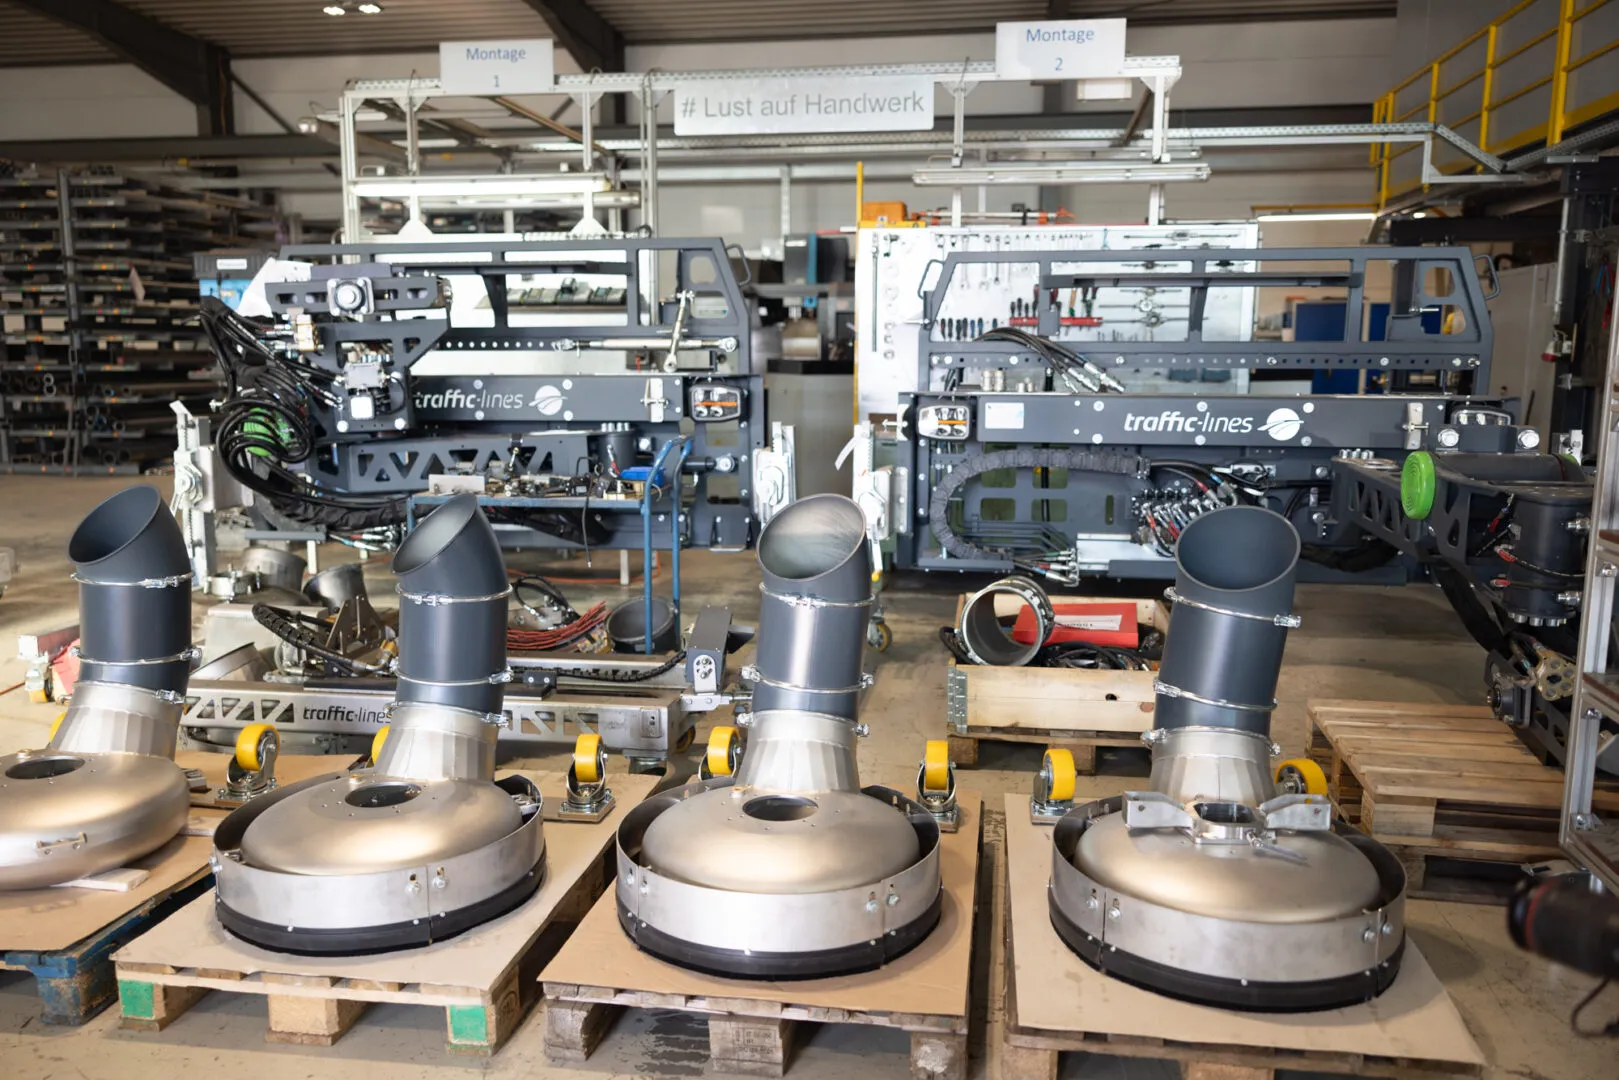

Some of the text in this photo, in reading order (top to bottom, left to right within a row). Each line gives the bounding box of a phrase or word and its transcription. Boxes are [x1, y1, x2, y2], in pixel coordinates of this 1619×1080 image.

[1026, 28, 1095, 44] Montage
[466, 47, 527, 63] Montage
[1055, 57, 1064, 71] 2
[494, 75, 500, 88] 1
[681, 91, 925, 118] # Lust auf Handwerk
